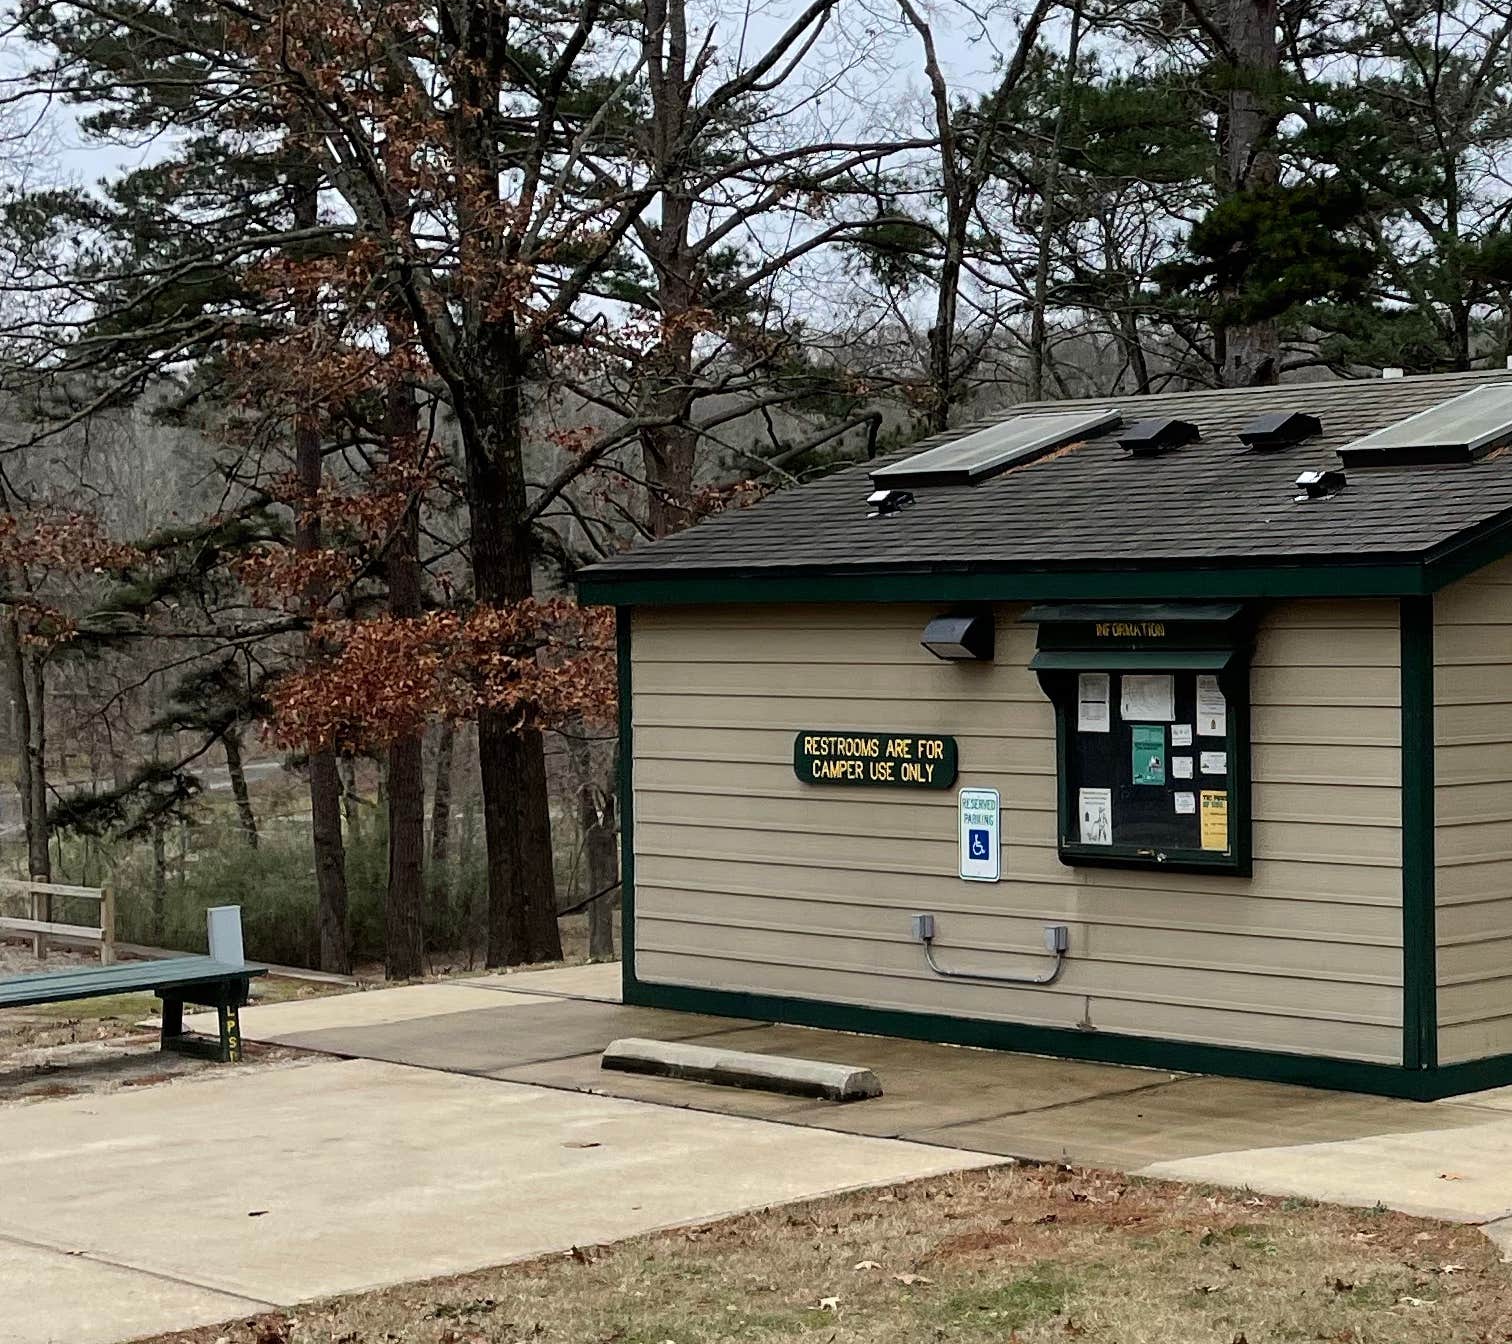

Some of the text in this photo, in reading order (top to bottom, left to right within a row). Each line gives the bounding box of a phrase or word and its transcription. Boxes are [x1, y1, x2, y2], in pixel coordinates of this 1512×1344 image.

[1096, 623, 1165, 637] INFORMATION
[804, 736, 944, 760] RESTROOMS ARE FOR
[812, 759, 934, 783] CAMPER USE ONLY
[962, 798, 996, 811] RESERVED
[963, 813, 994, 826] PARKING
